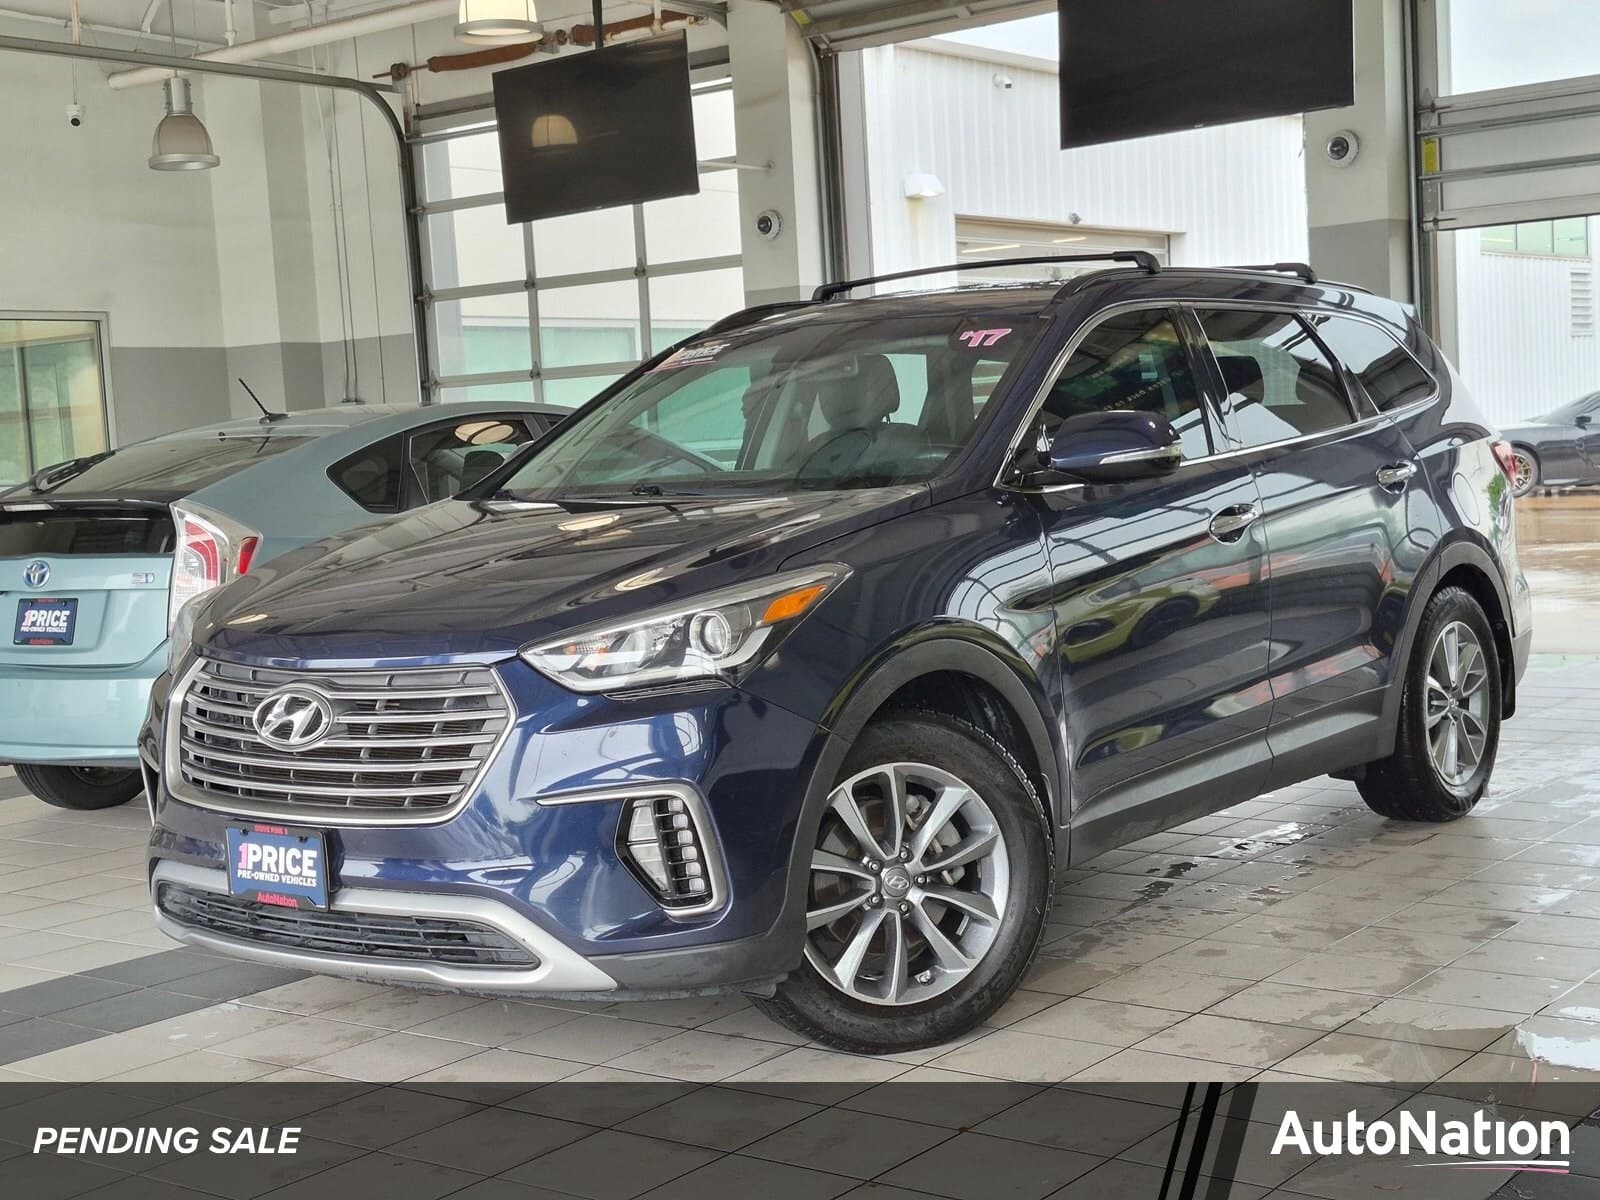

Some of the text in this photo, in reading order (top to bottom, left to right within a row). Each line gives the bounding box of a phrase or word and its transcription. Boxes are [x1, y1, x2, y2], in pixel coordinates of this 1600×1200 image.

[22, 610, 70, 627] 1PRICE
[238, 842, 318, 878] 1PRICE
[237, 869, 318, 888] PRE-OWNED VEHICLES
